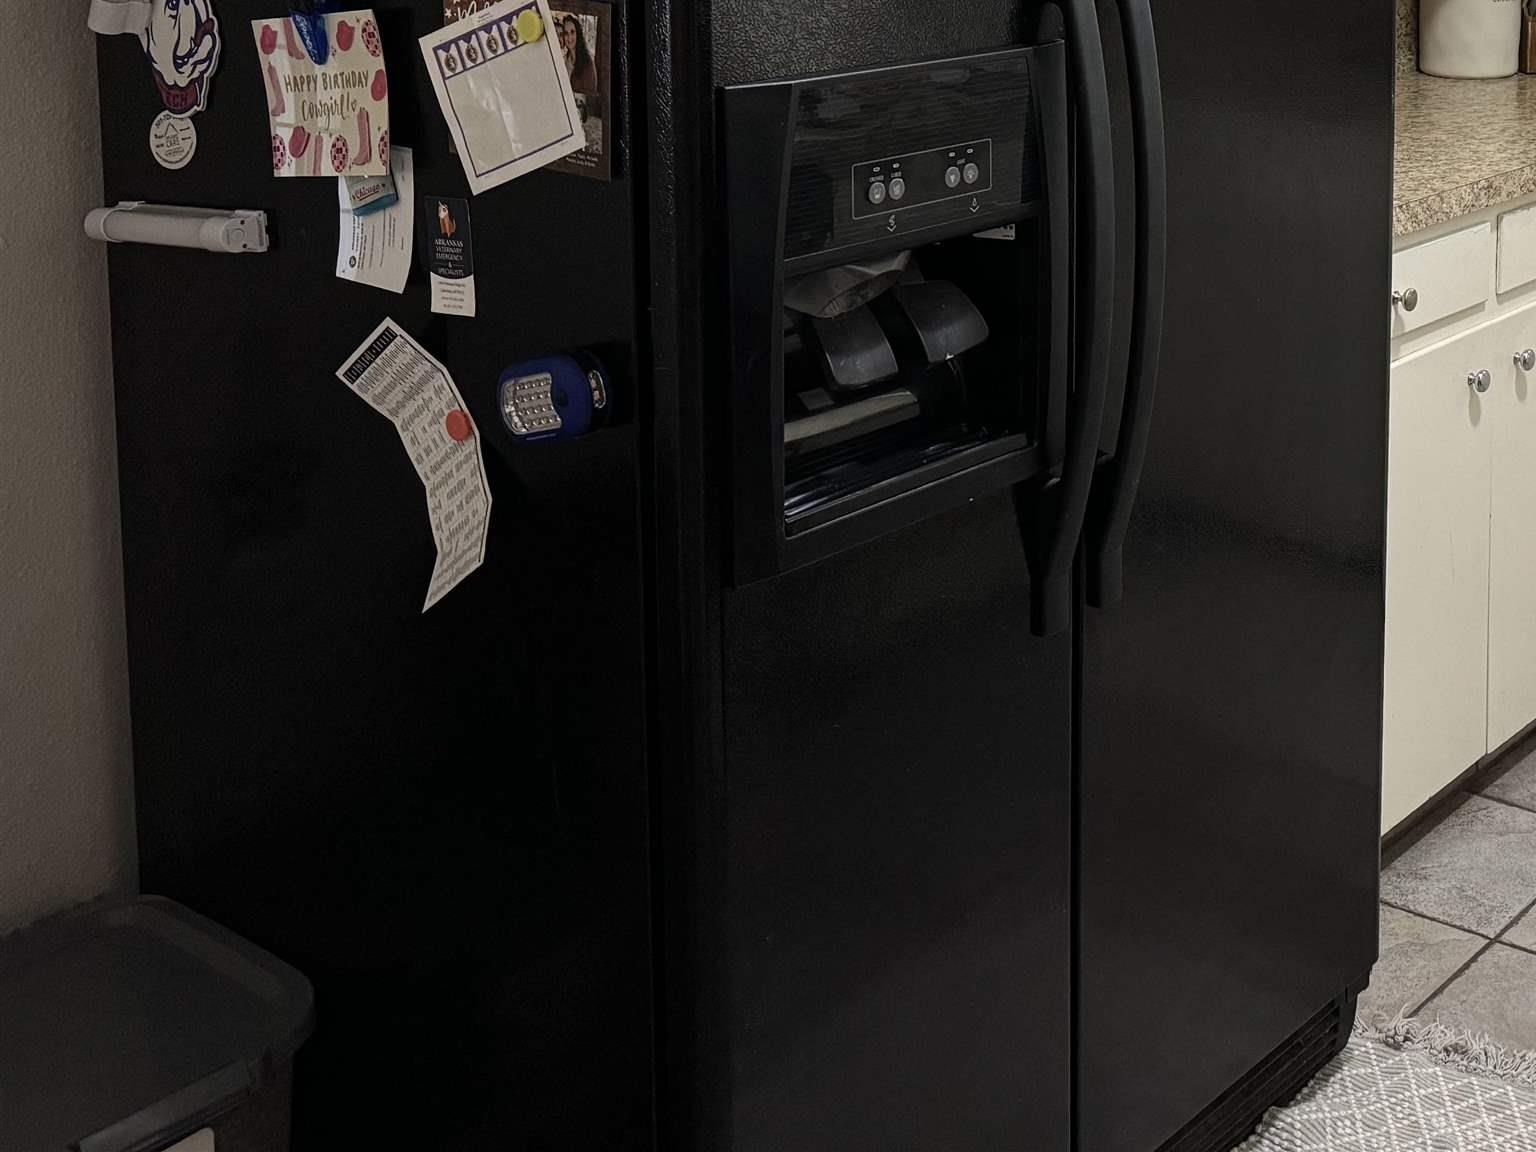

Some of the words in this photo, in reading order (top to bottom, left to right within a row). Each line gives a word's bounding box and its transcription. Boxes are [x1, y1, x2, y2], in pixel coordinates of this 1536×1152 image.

[283, 72, 319, 93] HAPPY
[321, 70, 369, 91] BIRTHDAY
[355, 183, 382, 201] Chicago
[434, 239, 464, 248] ARKANSAS
